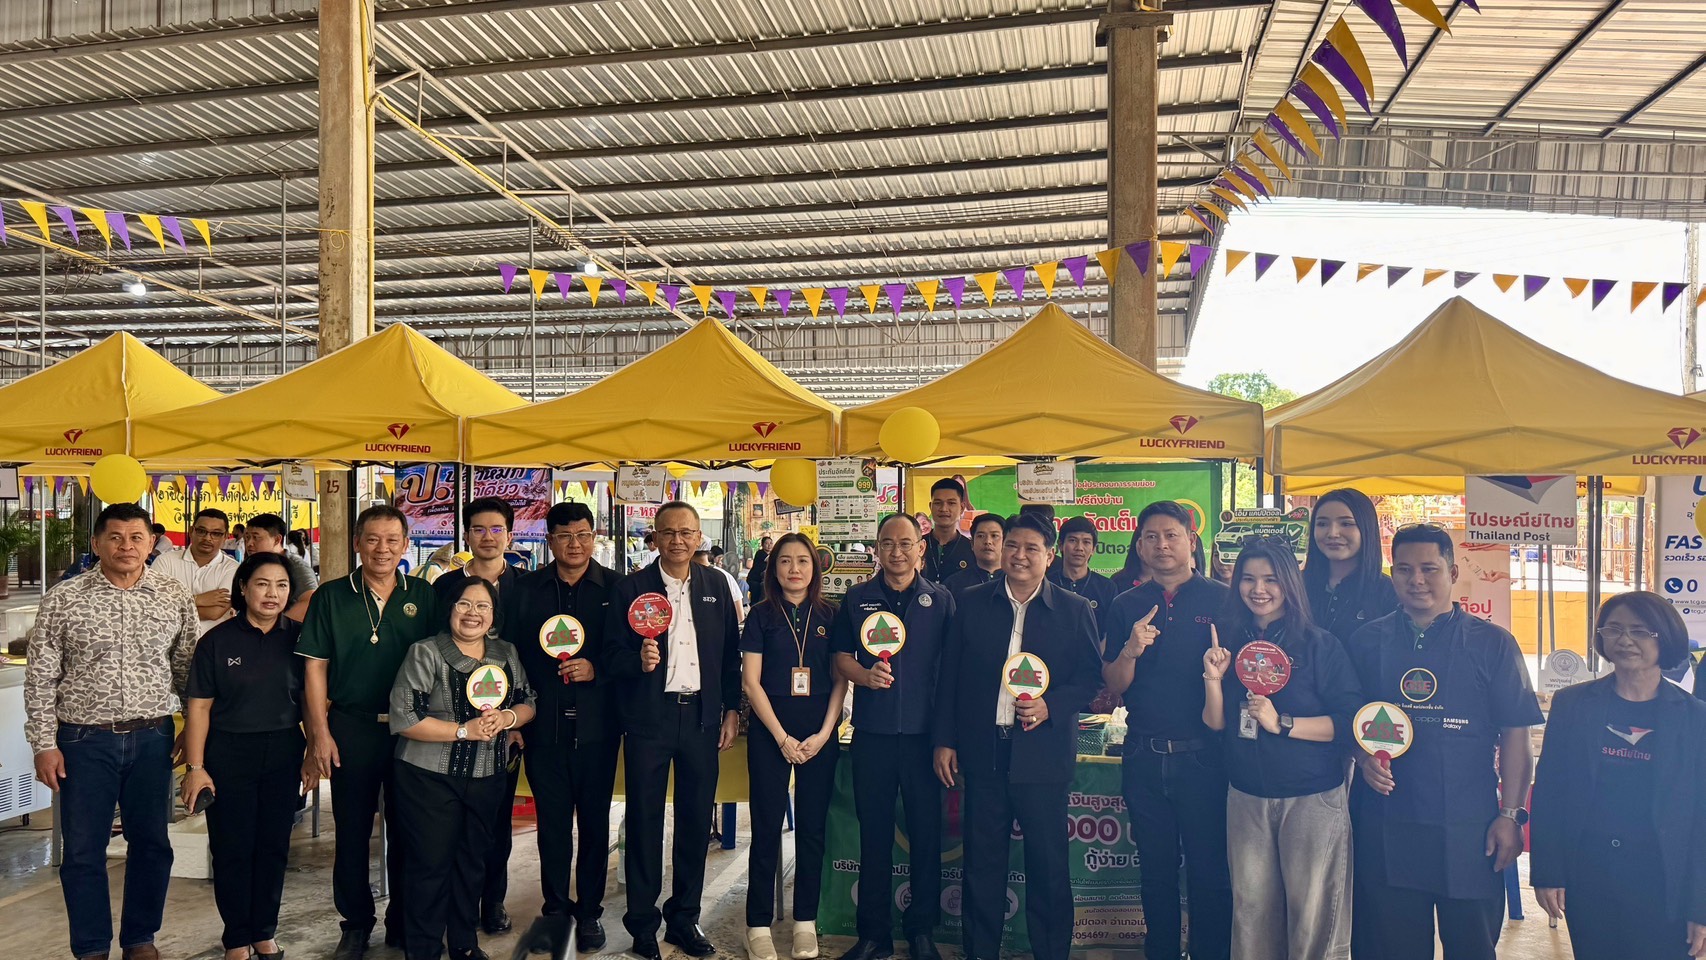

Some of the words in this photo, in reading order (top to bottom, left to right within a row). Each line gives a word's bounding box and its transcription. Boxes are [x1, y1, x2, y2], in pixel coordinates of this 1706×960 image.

[365, 443, 431, 453] LUCKYFRIEND
[729, 442, 801, 451] LUCKYFRIEND
[1140, 438, 1225, 449] LUCKYFRIEND
[45, 447, 103, 457] LUCKYFRIEND
[858, 481, 870, 489] 999
[1076, 480, 1155, 490] อผู้ประกอบการรายย่อย
[1468, 510, 1575, 528] ไปรษณีย์ไทย
[1468, 531, 1520, 541] Thailand
[1523, 531, 1550, 541] Post
[1194, 615, 1212, 624] GSE
[546, 629, 578, 645] GSE
[867, 626, 899, 643] GSE
[1008, 668, 1043, 686] GSE
[472, 681, 502, 696] GSE
[1361, 720, 1404, 741] GSE
[1443, 723, 1462, 731] Galaxy
[1086, 849, 1127, 870] กู้ง่าย
[1118, 931, 1145, 940] 065-9
